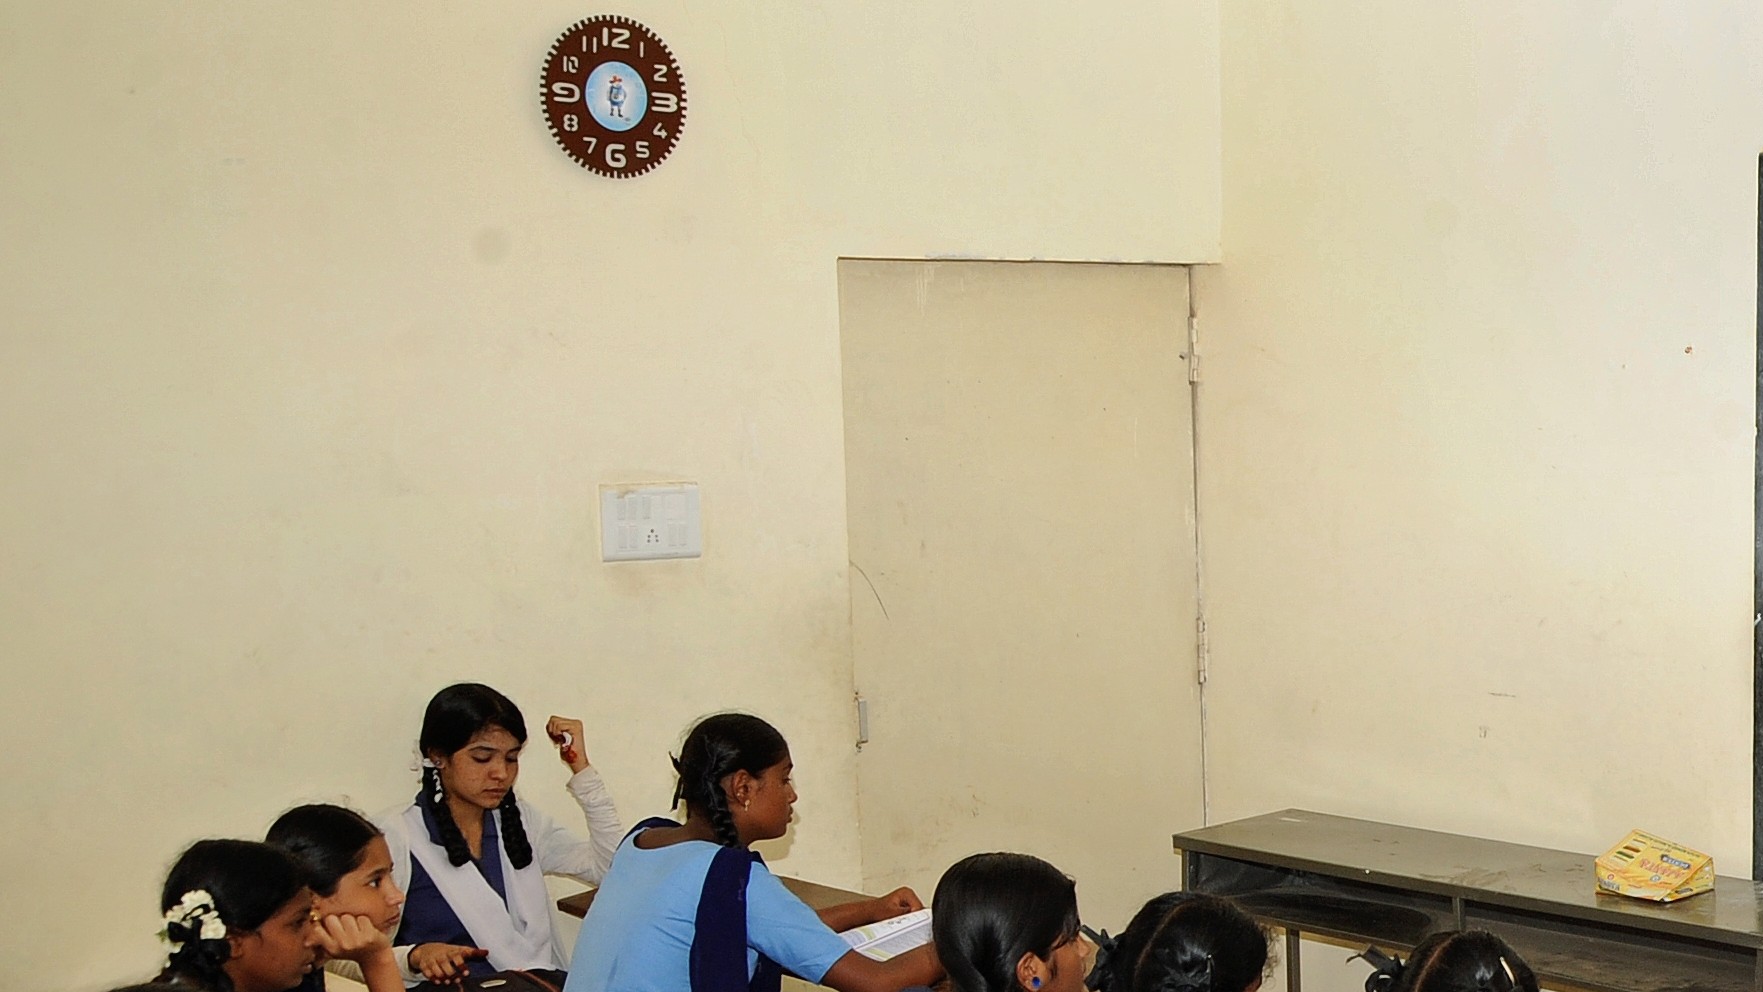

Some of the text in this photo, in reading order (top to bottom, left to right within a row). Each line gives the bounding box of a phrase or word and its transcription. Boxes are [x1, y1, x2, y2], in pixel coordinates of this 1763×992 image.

[582, 35, 598, 54] 11
[602, 26, 631, 49] 12
[639, 41, 645, 58] 1
[563, 55, 579, 74] 10
[653, 63, 668, 83] 2
[551, 81, 581, 103] 9
[651, 91, 679, 113] 3
[563, 113, 579, 132] 8
[652, 122, 668, 139] 4
[582, 136, 598, 154] 7
[635, 140, 650, 159] 5
[605, 143, 628, 168] 6
